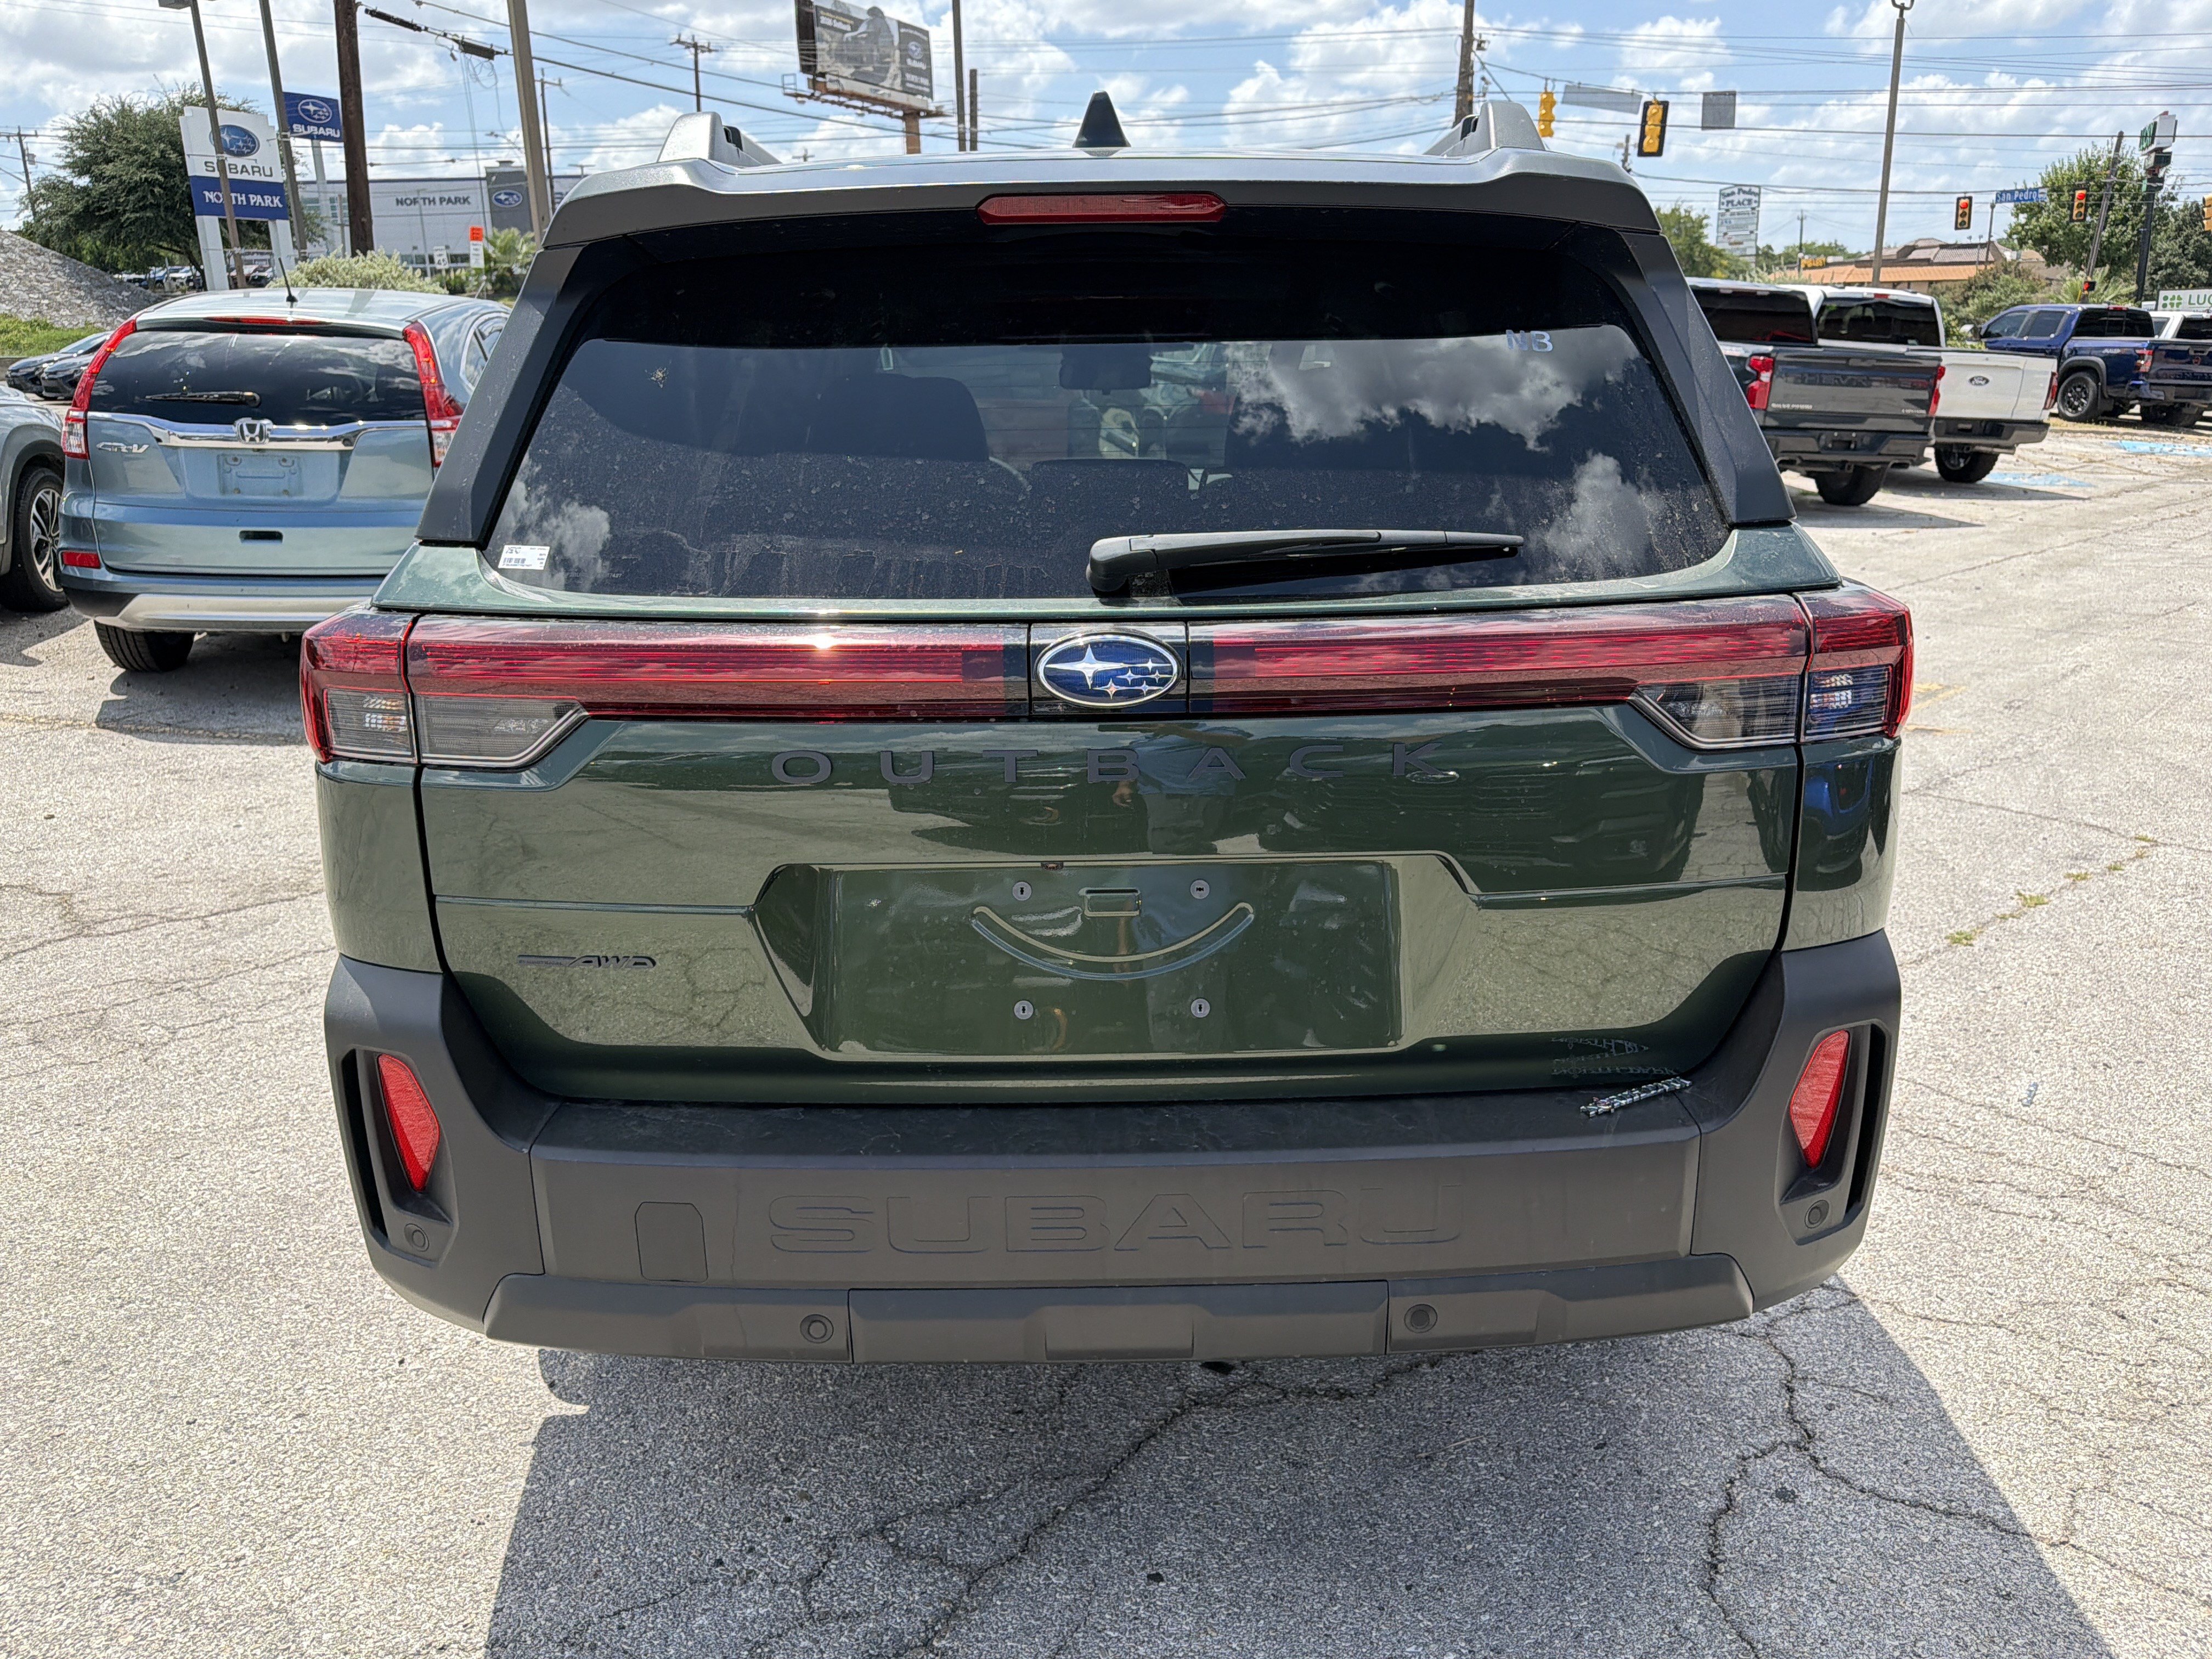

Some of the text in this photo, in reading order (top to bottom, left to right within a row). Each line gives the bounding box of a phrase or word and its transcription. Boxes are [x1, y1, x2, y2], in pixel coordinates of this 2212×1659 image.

[293, 123, 340, 138] SUBARU
[204, 161, 273, 178] SBARU
[203, 190, 283, 208] NOTH PARK
[439, 195, 471, 206] PARK
[1997, 191, 2012, 204] San
[2013, 189, 2038, 201] Pedro
[1505, 329, 1553, 352] NB
[770, 743, 1442, 784] OUTBACK
[568, 955, 657, 969] AWD
[769, 1185, 1462, 1253] SUBARU
